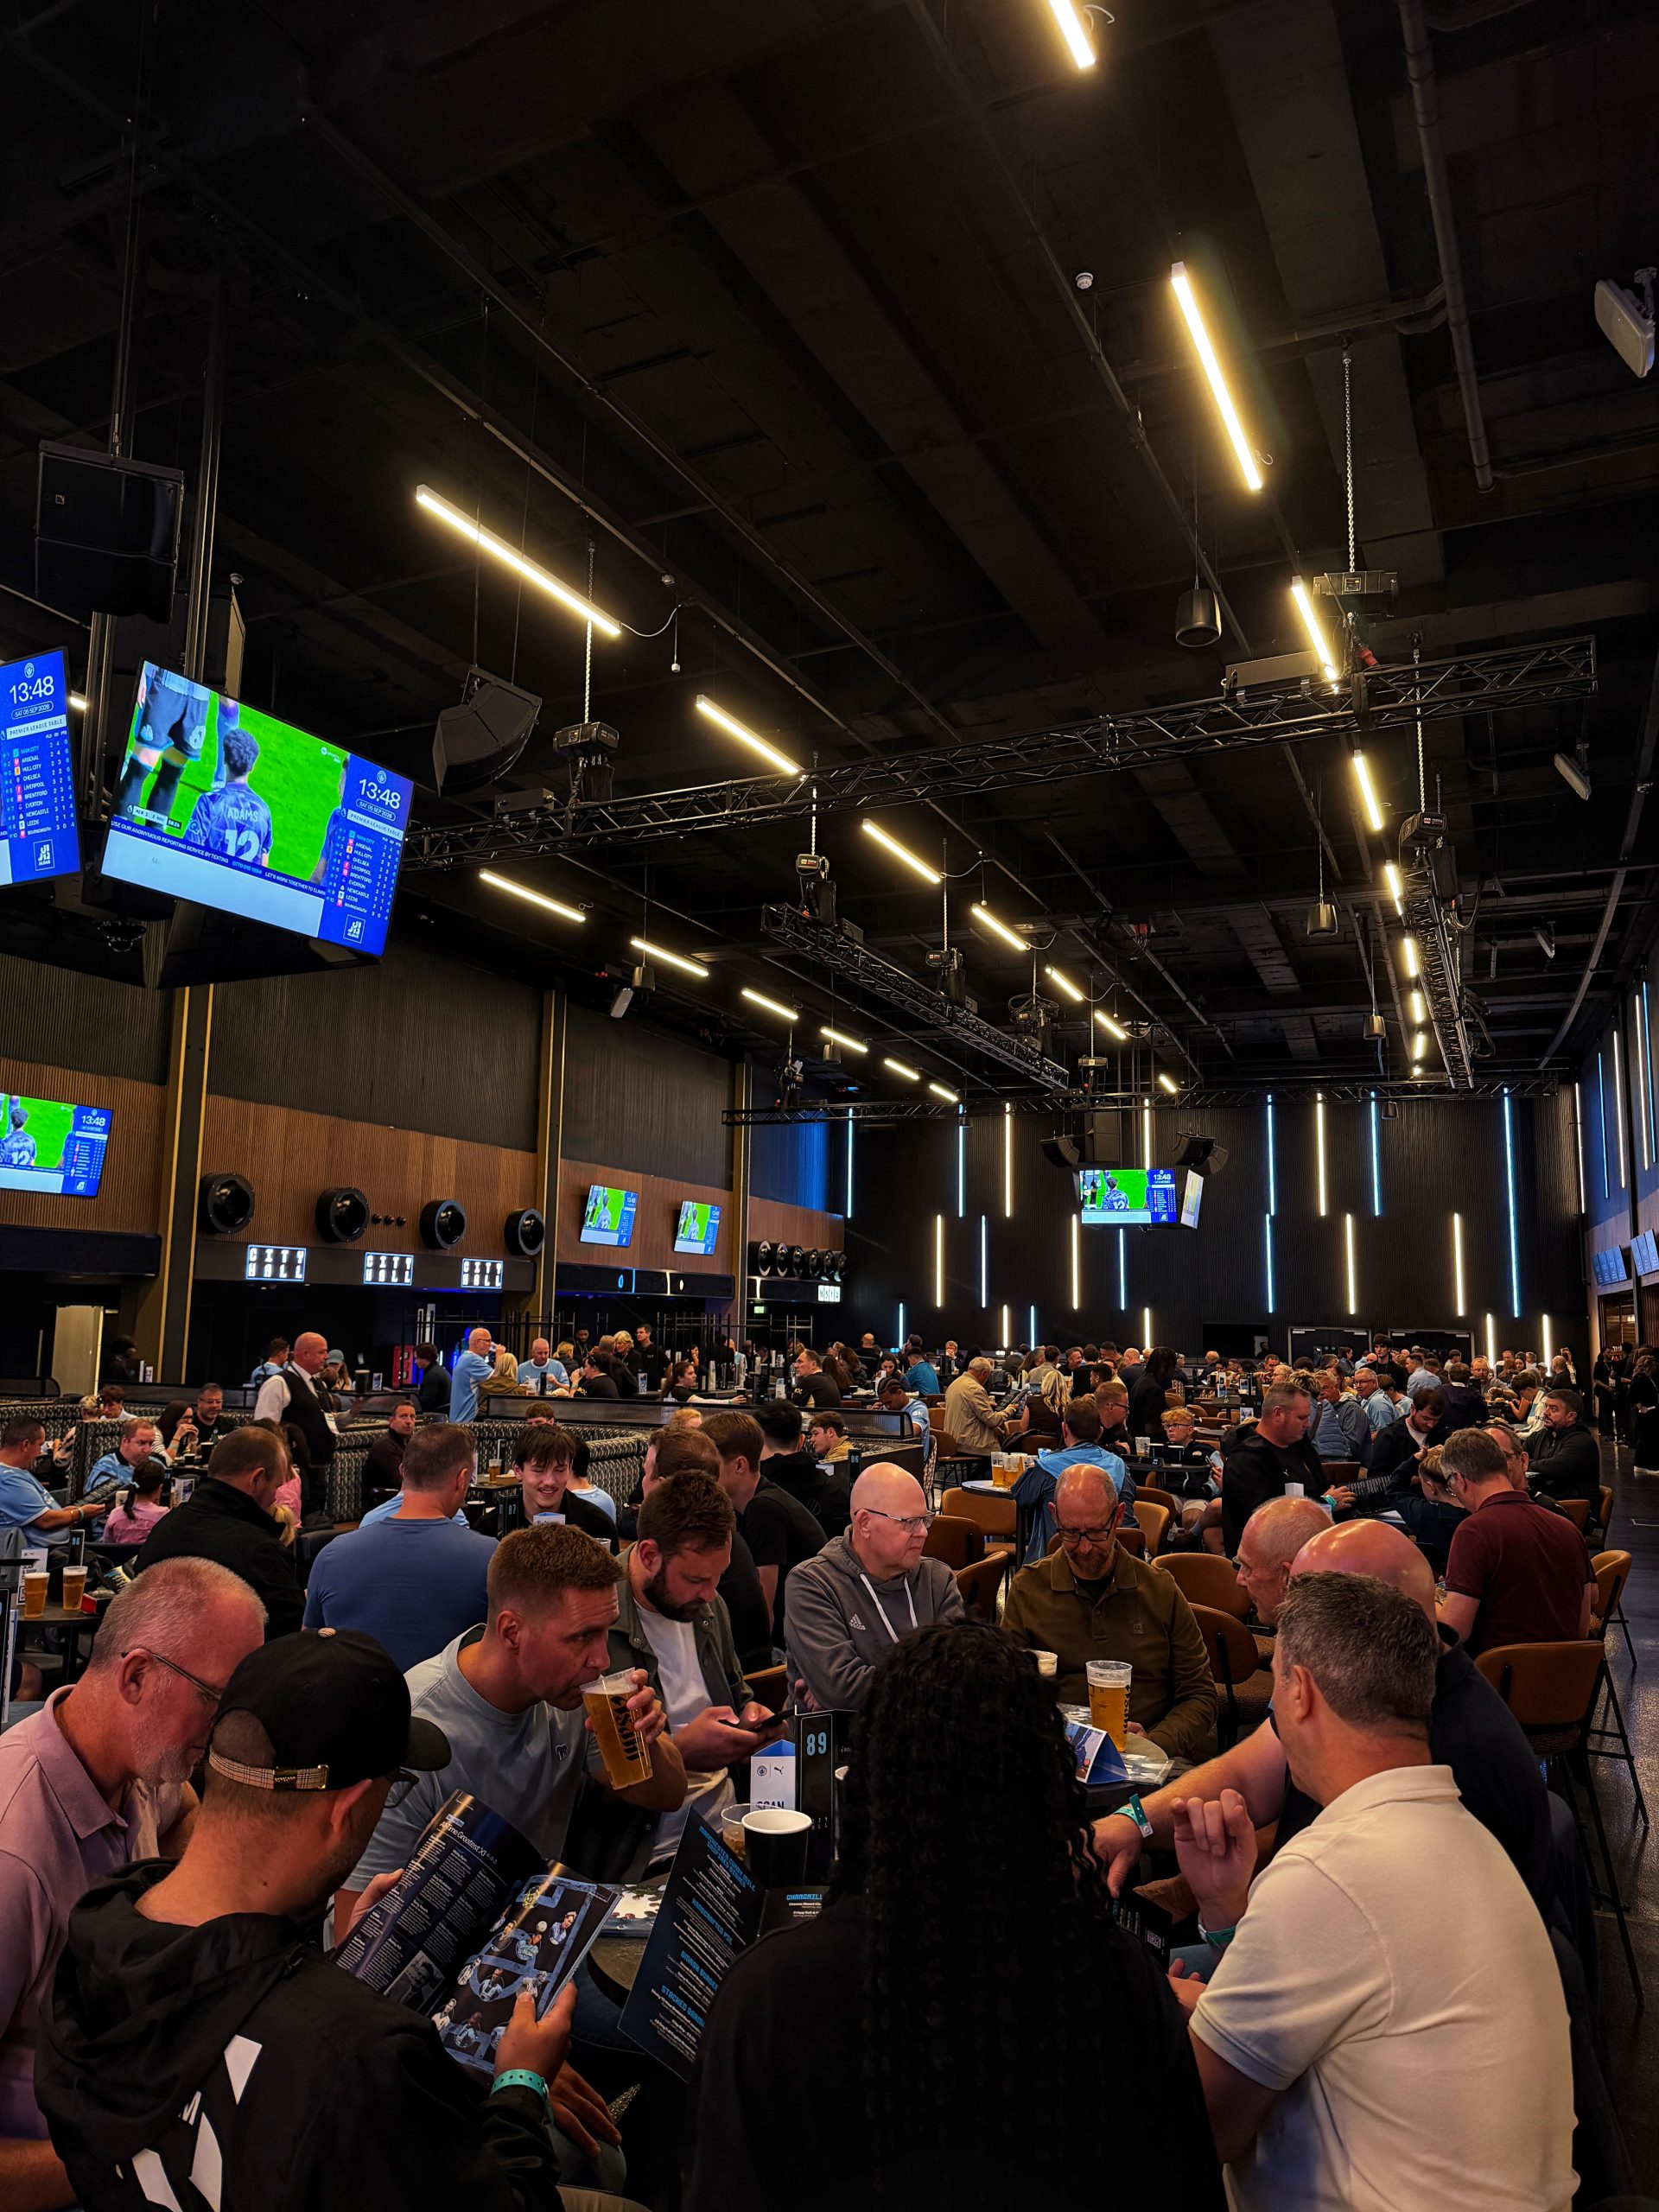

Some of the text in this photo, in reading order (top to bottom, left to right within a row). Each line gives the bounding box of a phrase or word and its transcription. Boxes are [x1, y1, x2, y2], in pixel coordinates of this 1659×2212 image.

[10, 676, 54, 704] 13:48
[10, 718, 63, 736] PREMIER LEAGUE TABLE
[24, 782, 45, 791] LIVERPOOL
[25, 790, 48, 799] BRENTFORD
[359, 779, 401, 810] 13:48
[26, 800, 43, 809] EVERTON
[26, 808, 49, 817] NEWCASTLE
[227, 807, 258, 822] ADAMS
[350, 812, 401, 837] PREMIER LEAGUE TABLE
[225, 829, 259, 863] 12
[356, 842, 372, 852] ARSENAL
[121, 823, 132, 832] OUR
[131, 827, 161, 842] ANONYMOUS
[162, 836, 187, 849] REPORTING
[187, 845, 205, 856] SERVICE
[211, 852, 229, 863] TEXTING
[276, 874, 288, 884] WORK
[289, 879, 308, 890] TOGETHER
[353, 857, 369, 867] CHELSEA
[352, 865, 371, 875] LIVERPOOL
[349, 880, 365, 889] EVERTON
[350, 873, 372, 883] BRENTFORD
[347, 887, 369, 899] NEWCASTLE
[81, 1115, 105, 1126] 13:48
[11, 1150, 30, 1166] 12
[249, 1248, 303, 1264] CITY
[365, 1255, 412, 1269] CITY
[248, 1263, 303, 1279] HALL
[463, 1261, 502, 1274] CITY
[365, 1268, 411, 1283] HALL
[462, 1273, 501, 1287] HALL
[806, 1732, 827, 1757] 89
[457, 1831, 480, 1852] Greatest
[486, 1853, 498, 1865] 4-3-3
[661, 1985, 687, 2011] STACKED
